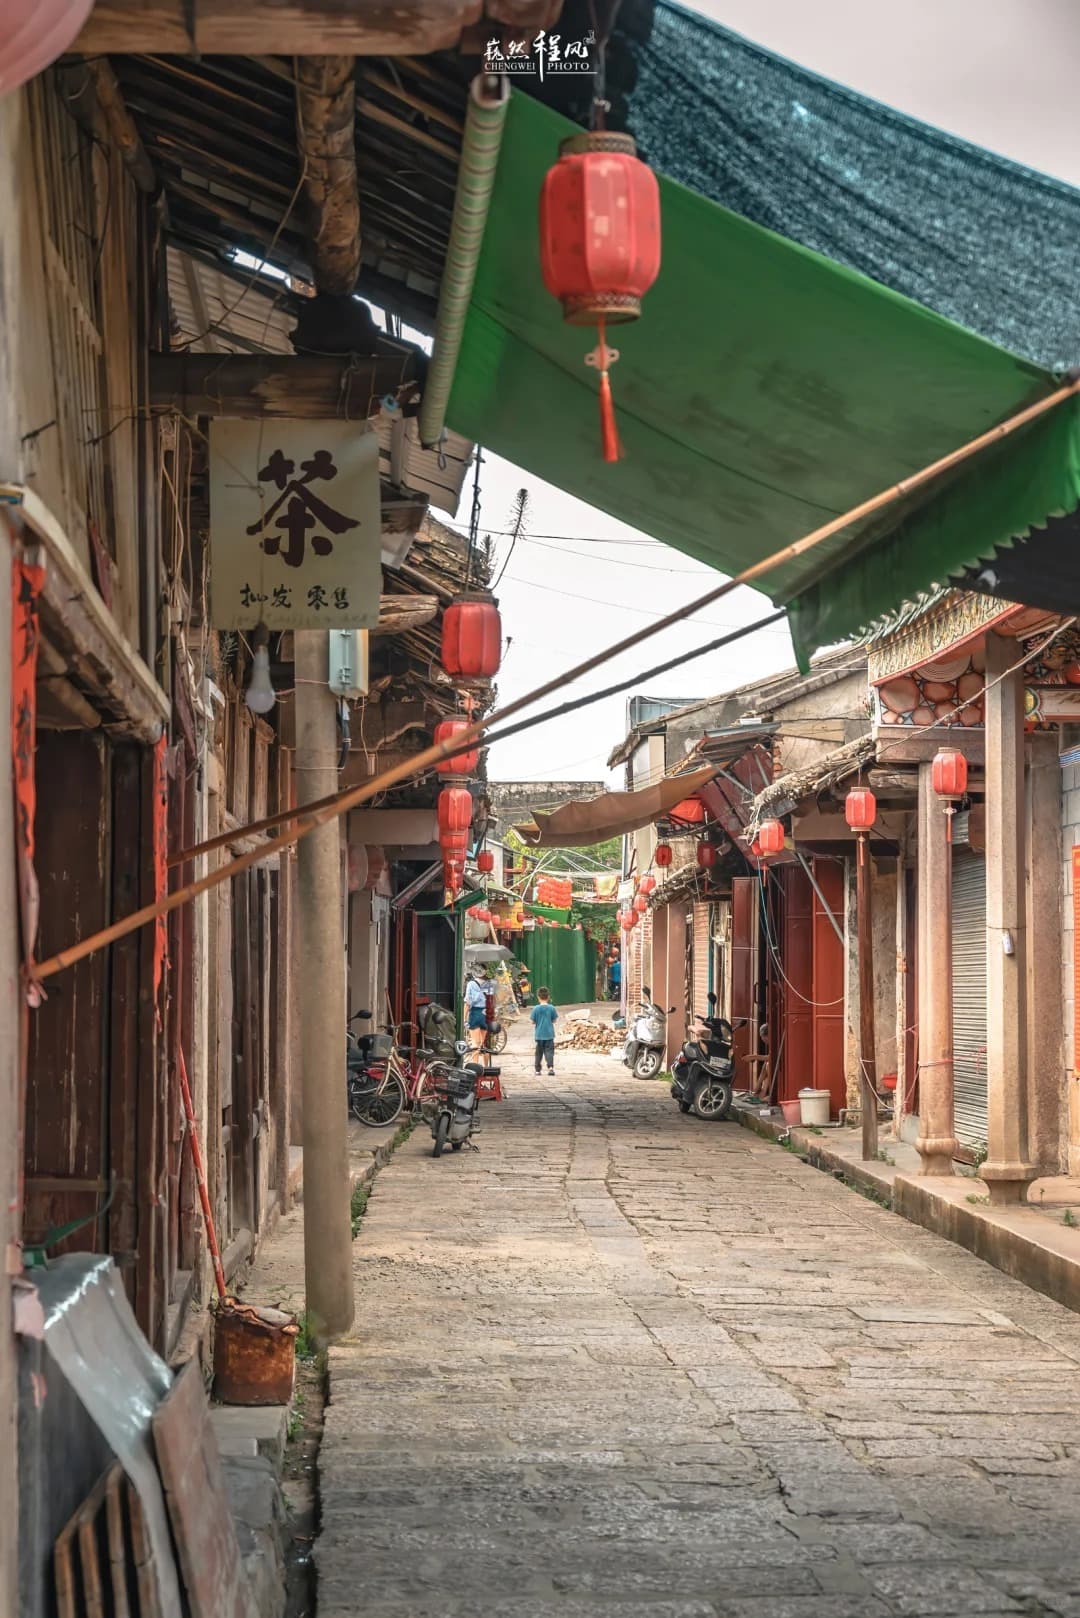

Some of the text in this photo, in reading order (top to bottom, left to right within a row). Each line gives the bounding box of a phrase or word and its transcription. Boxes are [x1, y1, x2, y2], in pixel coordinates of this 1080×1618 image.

[246, 449, 361, 568] 茶
[239, 582, 350, 611] 批发 零售
